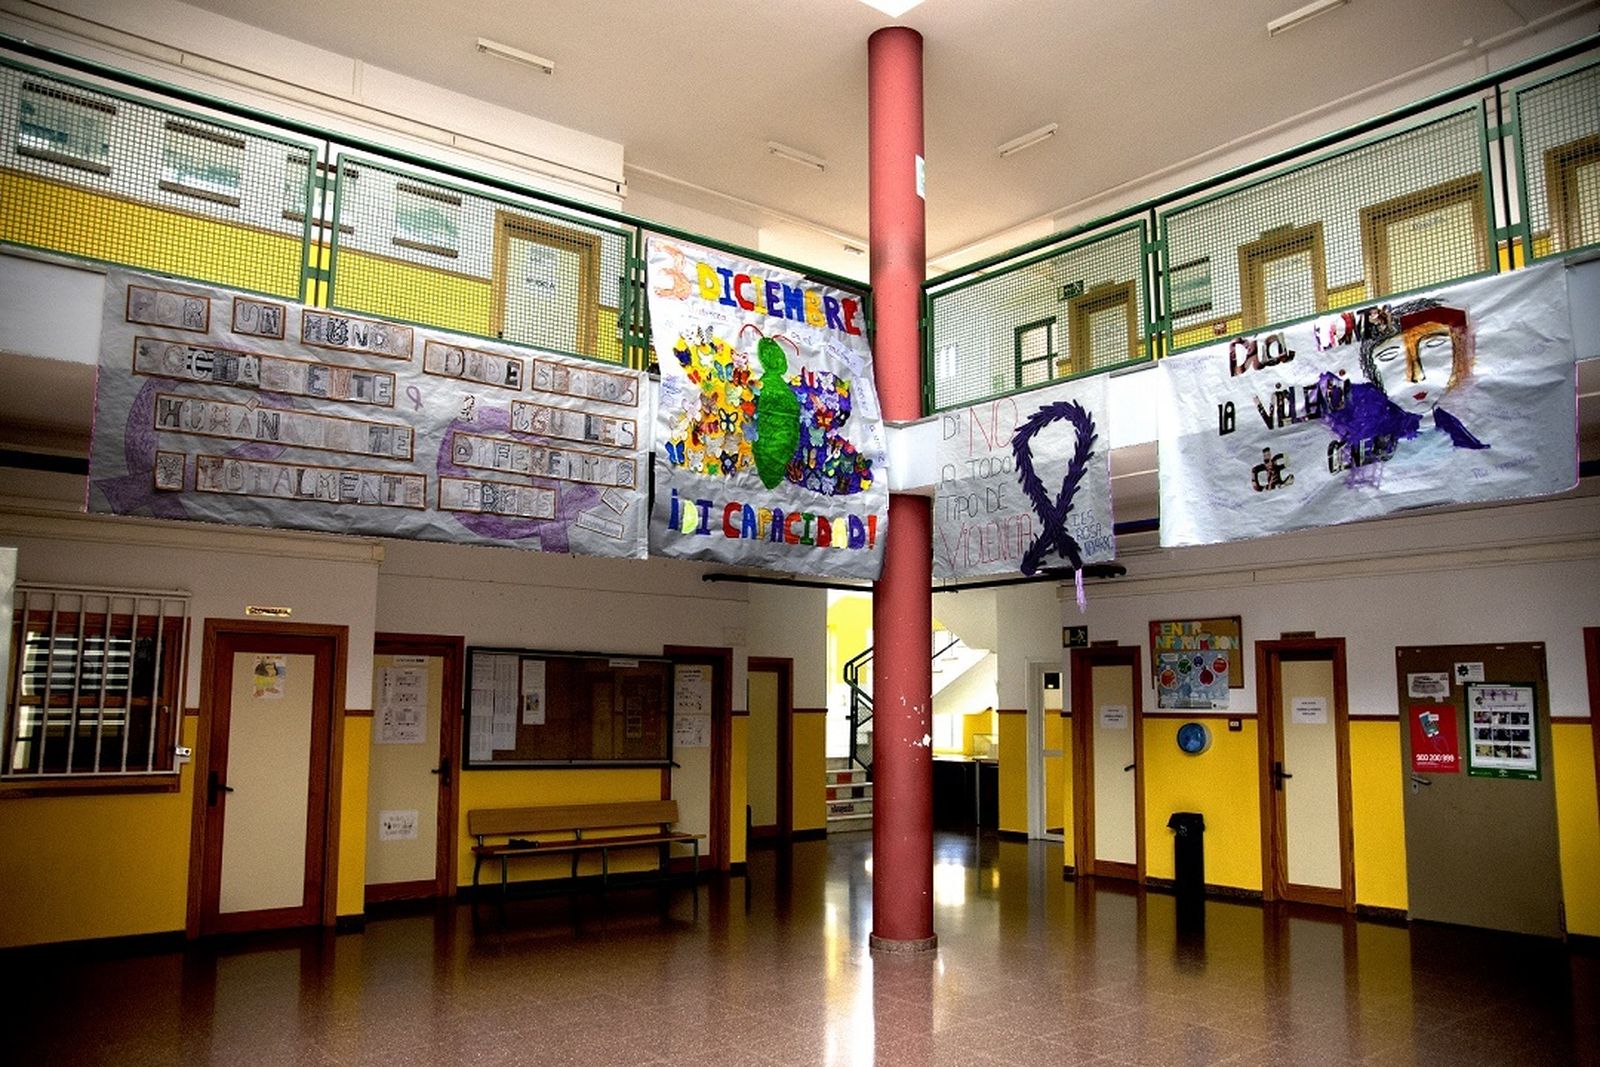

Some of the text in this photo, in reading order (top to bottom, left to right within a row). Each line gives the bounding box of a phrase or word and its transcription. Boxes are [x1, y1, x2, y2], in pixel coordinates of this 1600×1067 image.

[653, 242, 861, 336] 3 DICIEMBRE
[236, 301, 281, 334] UN
[304, 314, 412, 358] MUNDO
[968, 397, 1018, 456] NO
[199, 459, 423, 506] TOTALMENTE
[441, 482, 551, 519] IBRES
[940, 456, 1012, 490] A TODO
[986, 482, 1009, 513] DE
[722, 501, 877, 550] CAPACIDAD!
[1076, 522, 1102, 541] ROSA
